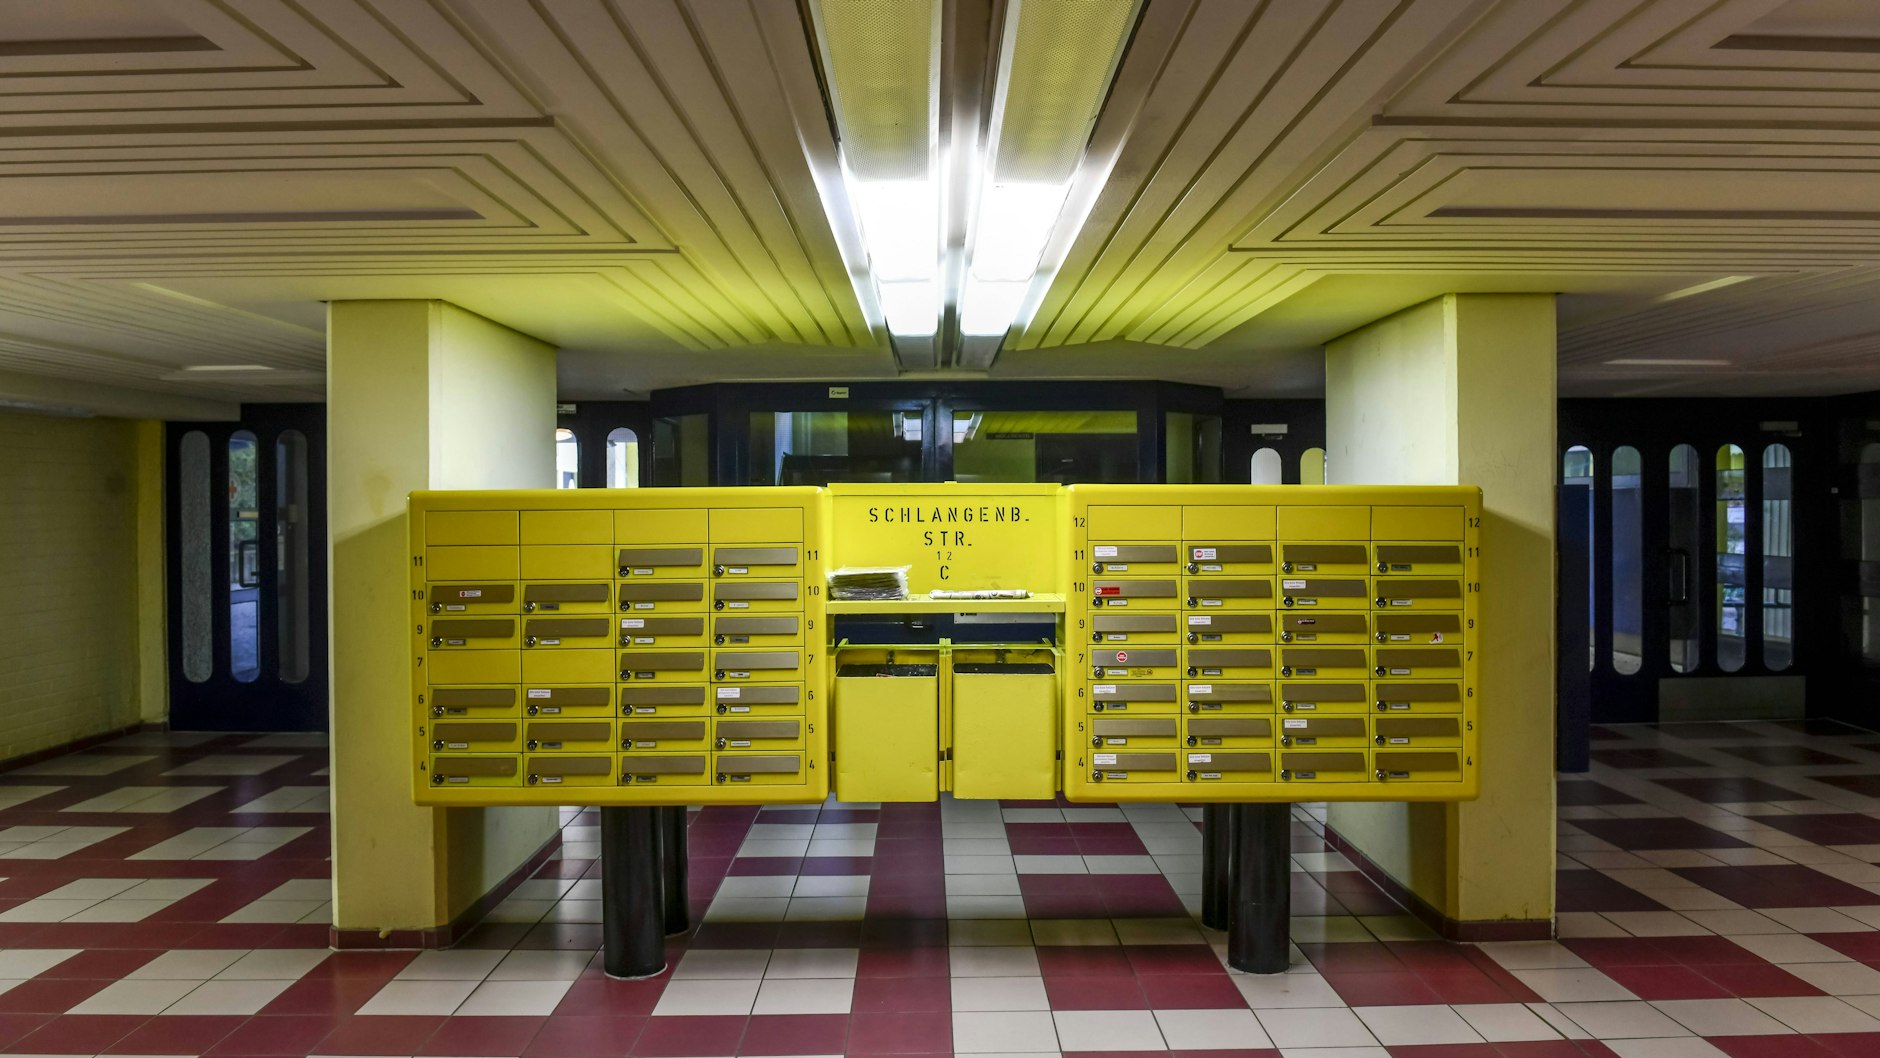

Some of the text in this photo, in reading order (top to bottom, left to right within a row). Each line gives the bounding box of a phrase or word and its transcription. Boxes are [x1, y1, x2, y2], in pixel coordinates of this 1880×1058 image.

[869, 506, 1030, 523] SCHLANGENB.
[1074, 518, 1086, 528] 12
[1468, 516, 1480, 528] 12
[924, 530, 972, 547] STR.
[808, 550, 818, 560] 11
[1074, 550, 1084, 560] 11
[1468, 546, 1480, 558] 11
[414, 556, 422, 566] 11
[940, 565, 949, 580] C
[808, 586, 820, 596] 10
[1074, 582, 1084, 592] 10
[1468, 582, 1480, 592] 10
[412, 590, 424, 600] 10
[808, 620, 814, 630] 9
[1078, 620, 1084, 628] 9
[1468, 618, 1474, 628] 9
[416, 624, 422, 634] 9
[418, 656, 424, 666] 7
[808, 654, 814, 664] 7
[1078, 654, 1084, 664] 7
[1468, 650, 1474, 662] 7
[808, 690, 814, 700] 6
[1078, 688, 1084, 698] 6
[1468, 688, 1472, 698] 6
[418, 694, 424, 704] 6
[808, 724, 814, 734] 5
[1078, 722, 1084, 732] 5
[1466, 720, 1472, 730] 5
[418, 726, 426, 736] 5
[810, 760, 814, 770] 4
[1078, 758, 1084, 768] 4
[1466, 756, 1472, 766] 4
[420, 762, 426, 772] 4
